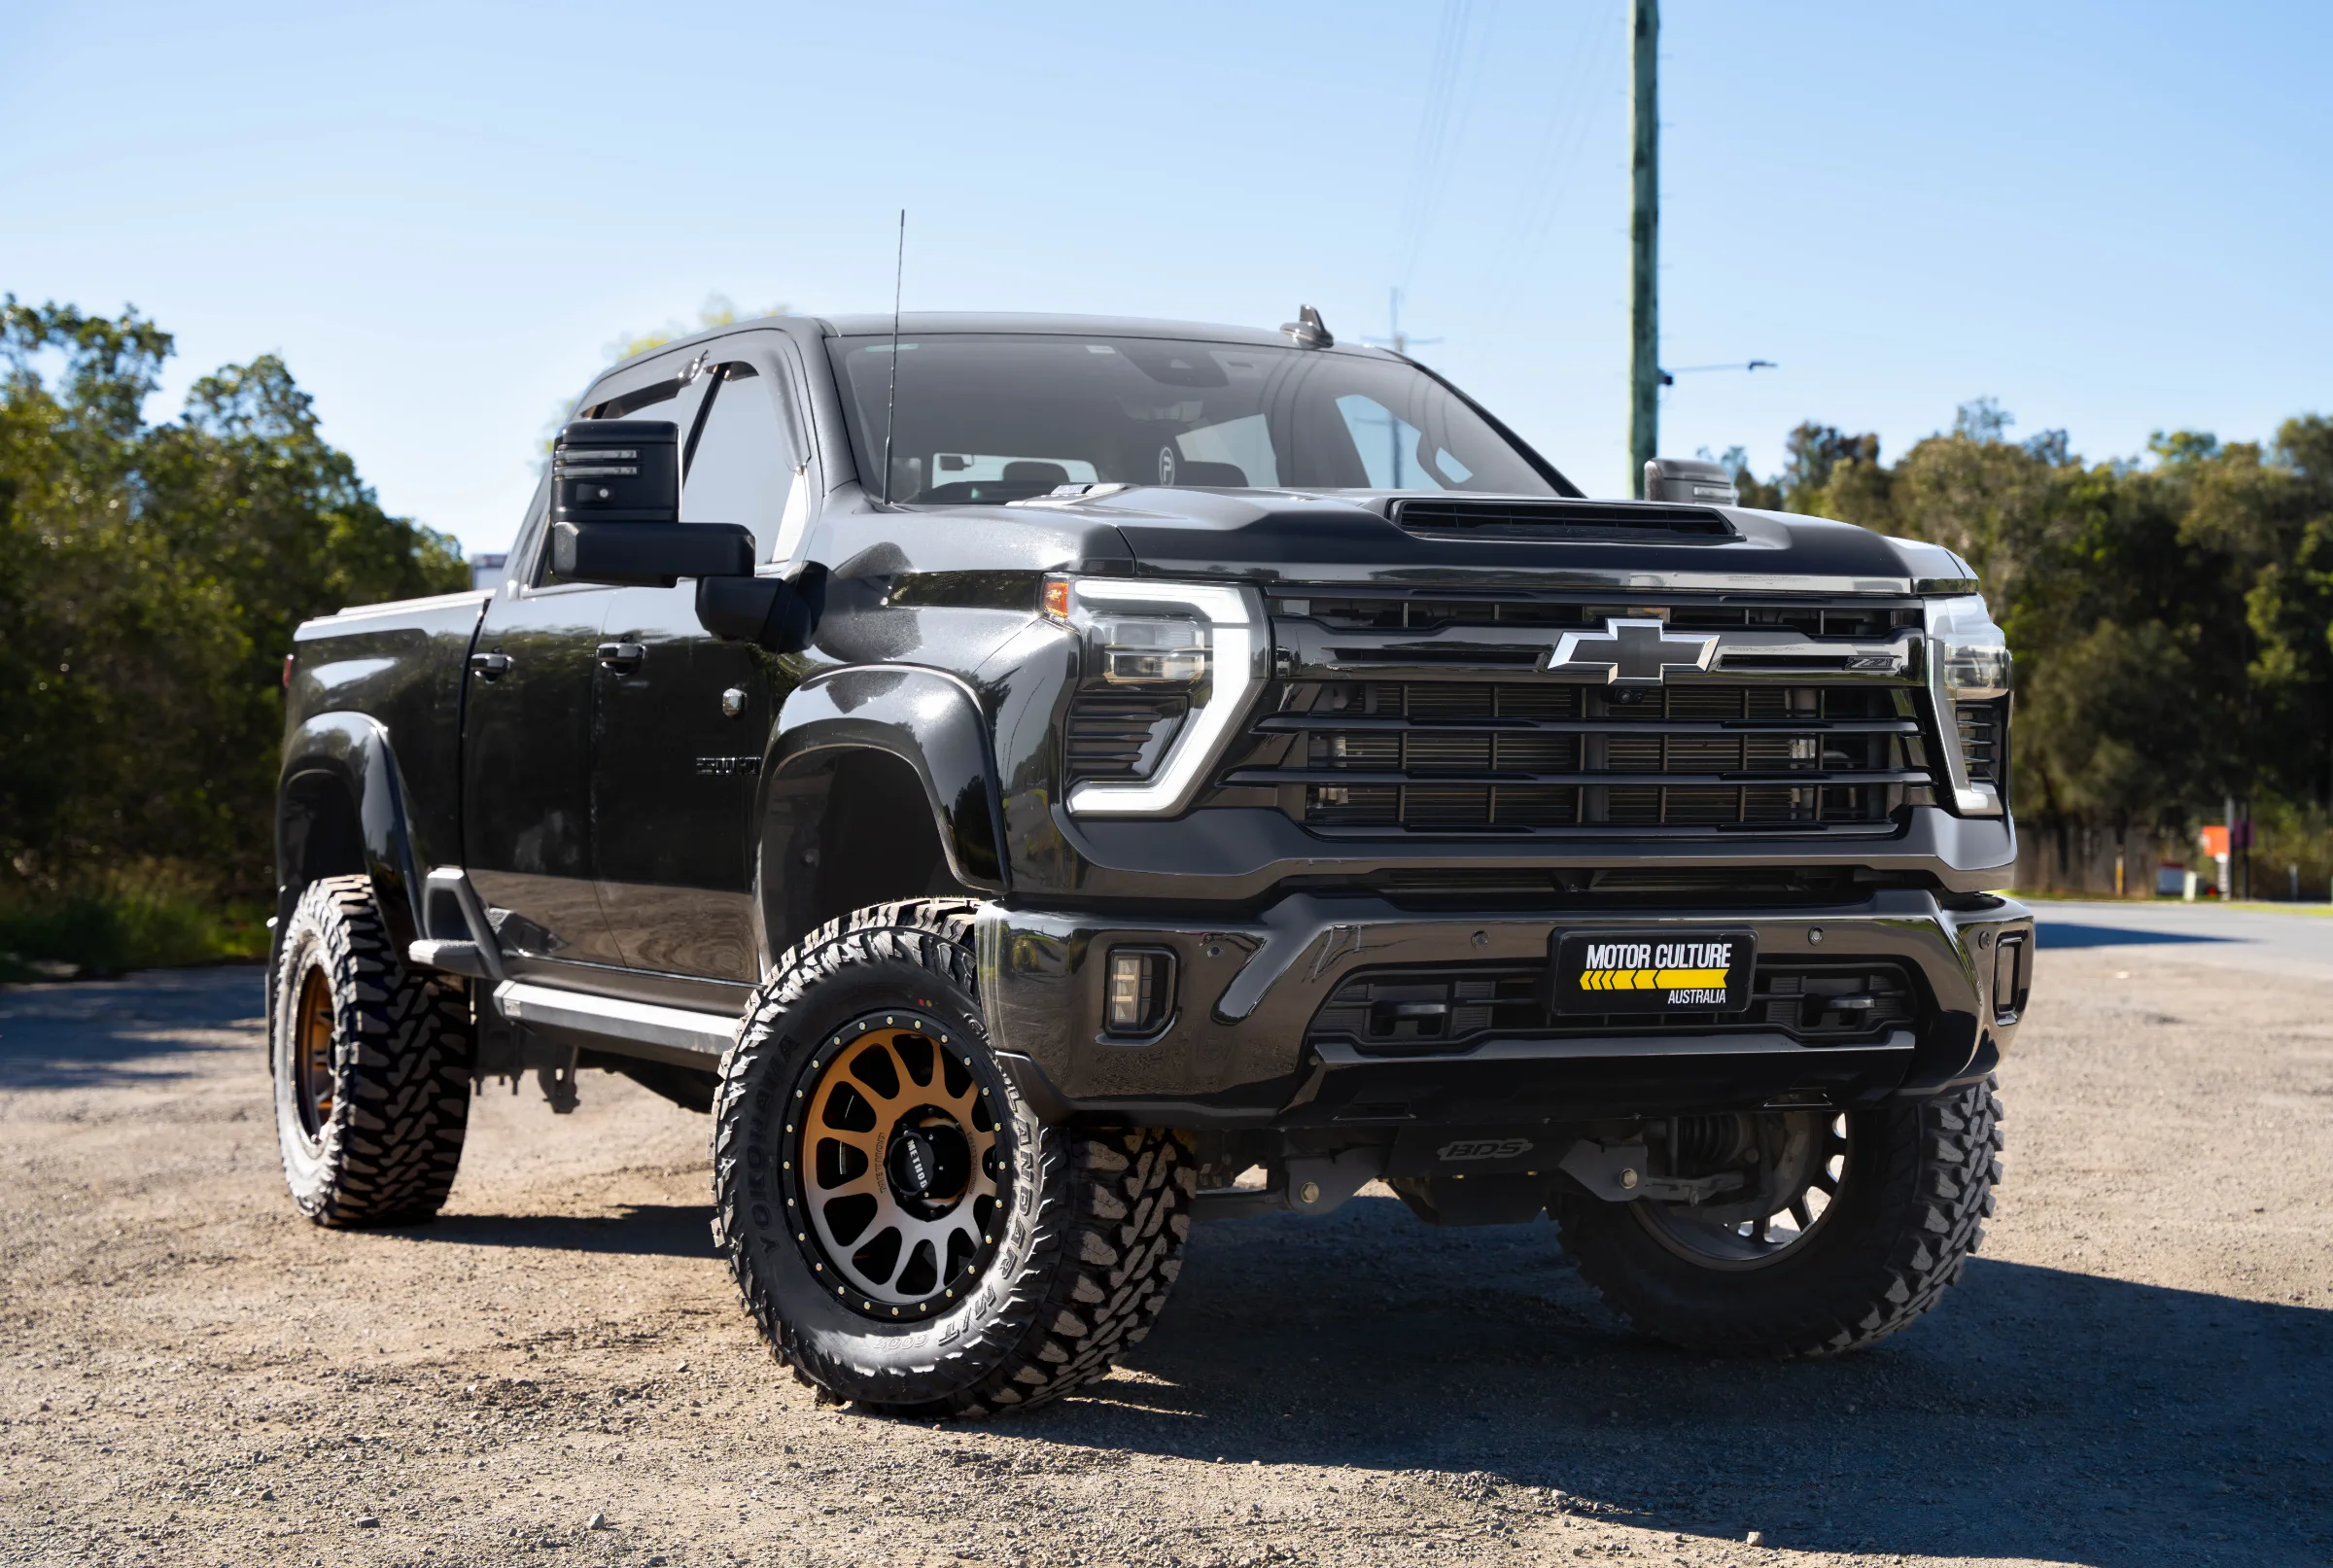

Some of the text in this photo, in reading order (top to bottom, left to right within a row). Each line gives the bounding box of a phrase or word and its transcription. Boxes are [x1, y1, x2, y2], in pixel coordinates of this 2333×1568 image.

[1586, 943, 1732, 969] MOTOR CULTURE
[1668, 989, 1726, 1004] AUSTRALIA
[747, 1033, 800, 1258] YOKOHAMA
[874, 1132, 888, 1194] METHOD
[906, 1138, 929, 1189] METHOD
[1445, 1140, 1524, 1158] BDS
[938, 1281, 996, 1347] M/T
